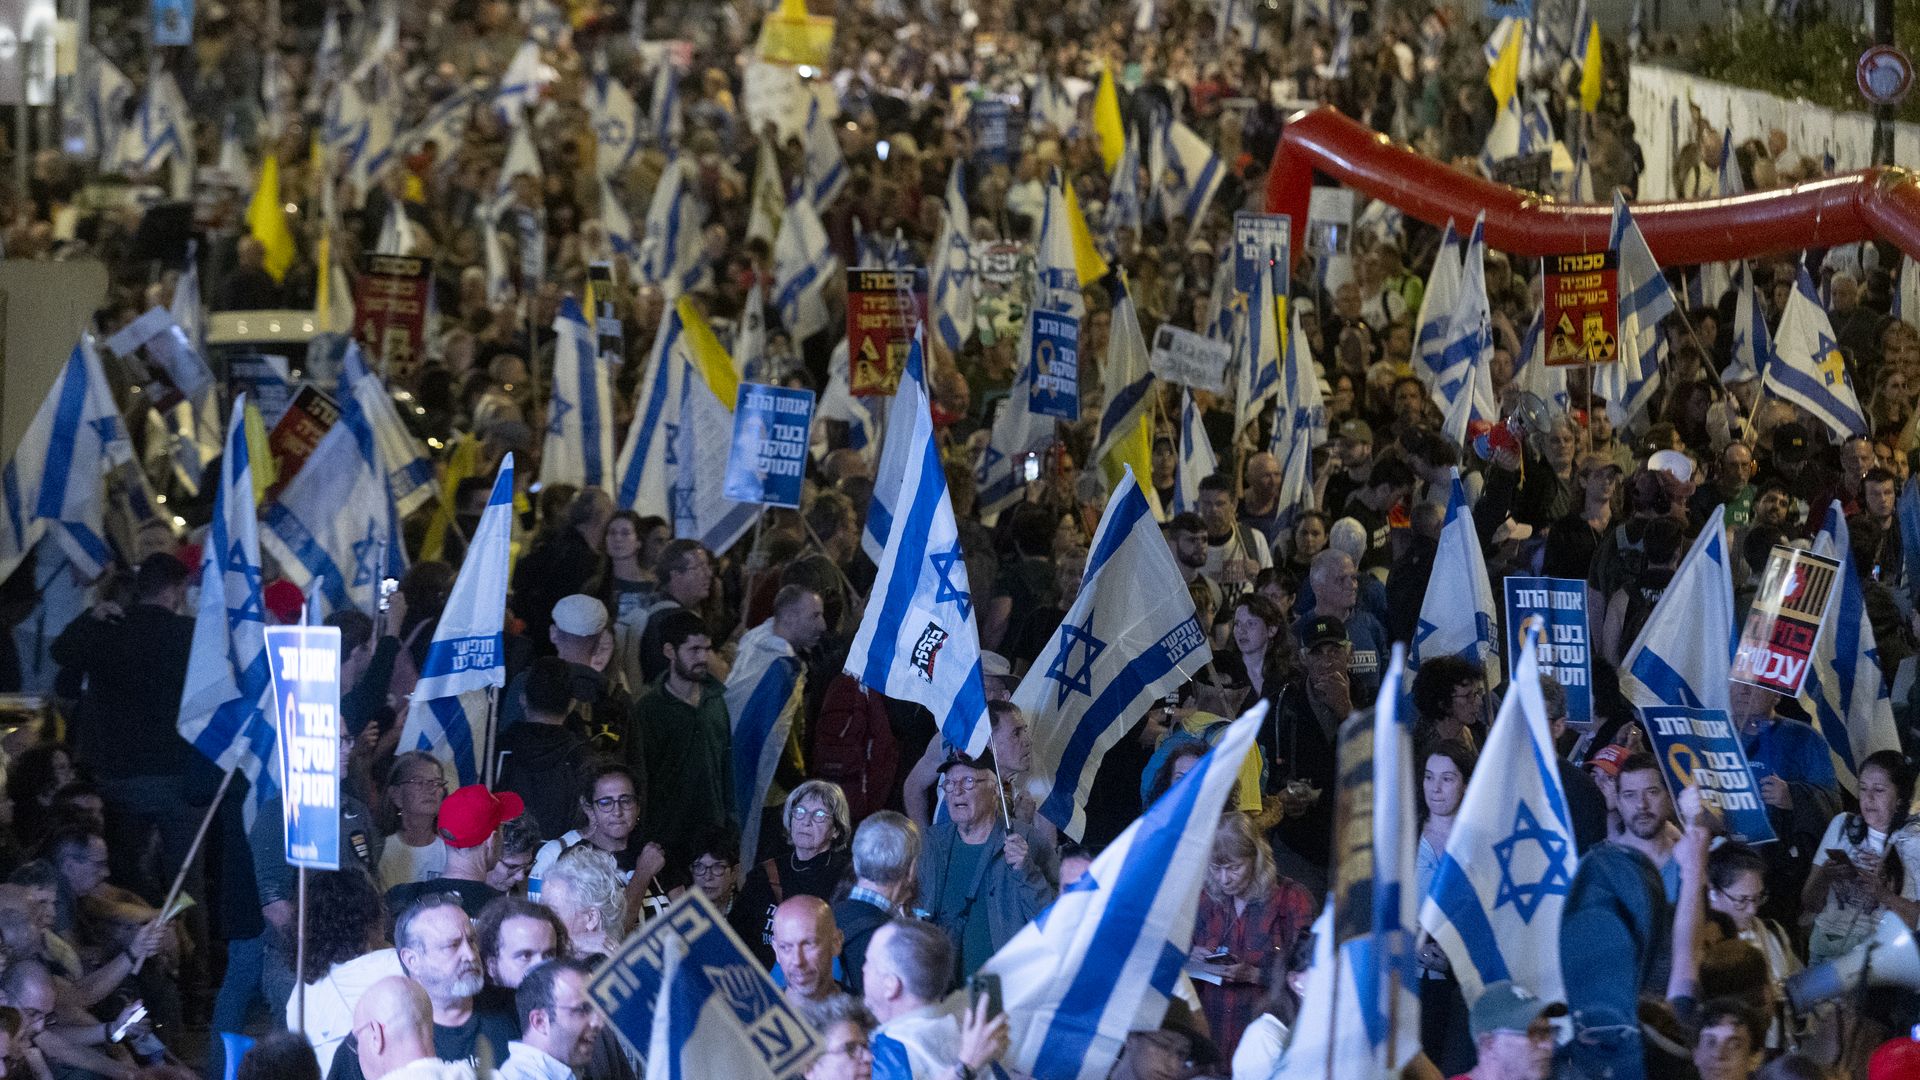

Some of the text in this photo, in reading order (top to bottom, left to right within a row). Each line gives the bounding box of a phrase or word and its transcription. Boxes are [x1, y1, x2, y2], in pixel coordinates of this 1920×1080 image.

[1558, 253, 1605, 273] סכנה!
[1560, 274, 1602, 291] כנופיה
[1554, 289, 1608, 309] בשלטון!
[775, 396, 810, 416] אנחנו
[773, 424, 805, 443] בעד
[1515, 589, 1583, 610] אנחנו הרוב
[1160, 617, 1199, 650] חופשי
[1552, 624, 1585, 644] בעד
[452, 638, 495, 656] חופשי
[1166, 629, 1206, 664] בארצנו
[1538, 643, 1585, 664] עסקת
[1737, 644, 1805, 685] עכשיו
[299, 702, 336, 738] בעד
[1653, 717, 1693, 736] הרוב
[1701, 750, 1744, 771] בעד
[1692, 768, 1749, 790] עסקת
